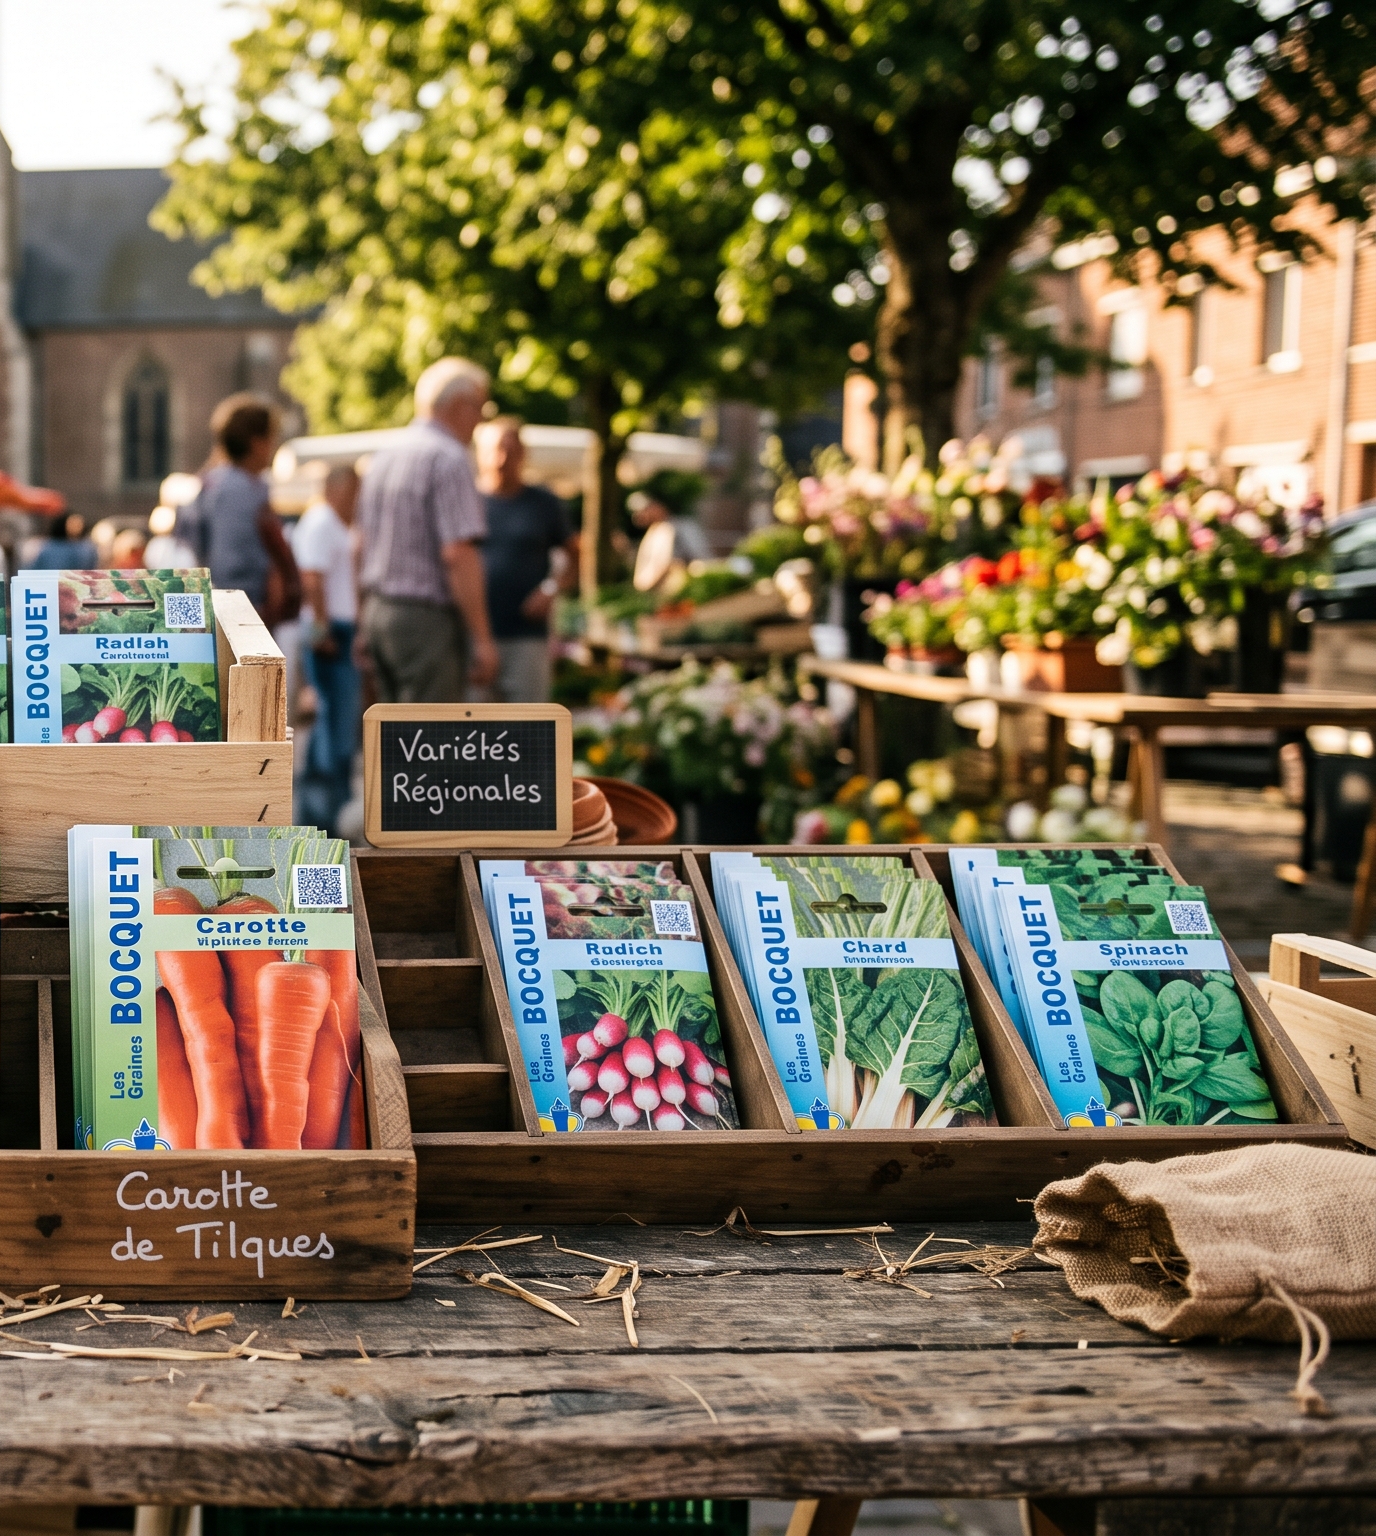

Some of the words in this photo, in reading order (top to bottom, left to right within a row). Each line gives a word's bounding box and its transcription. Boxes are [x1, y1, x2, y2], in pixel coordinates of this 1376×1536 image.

[24, 588, 51, 720] BOCQUET
[398, 728, 521, 763] Variétés
[392, 772, 542, 815] Régionales
[109, 850, 143, 1025] BOCQUET
[196, 917, 307, 934] Carotte
[842, 940, 908, 954] Chard
[508, 892, 548, 1025] BOCQUET
[755, 890, 802, 1025] BOCQUET
[1018, 895, 1073, 1027] BOCQUET
[1098, 943, 1189, 959] Spinach
[127, 1035, 144, 1100] Graines
[785, 1060, 798, 1083] Les
[795, 1032, 813, 1083] Graines
[1059, 1060, 1072, 1084] Les
[1072, 1033, 1087, 1085] Graines
[109, 1071, 125, 1100] Les
[115, 1169, 278, 1211] Carotte
[110, 1226, 164, 1261] de
[175, 1220, 335, 1279] Tilques
